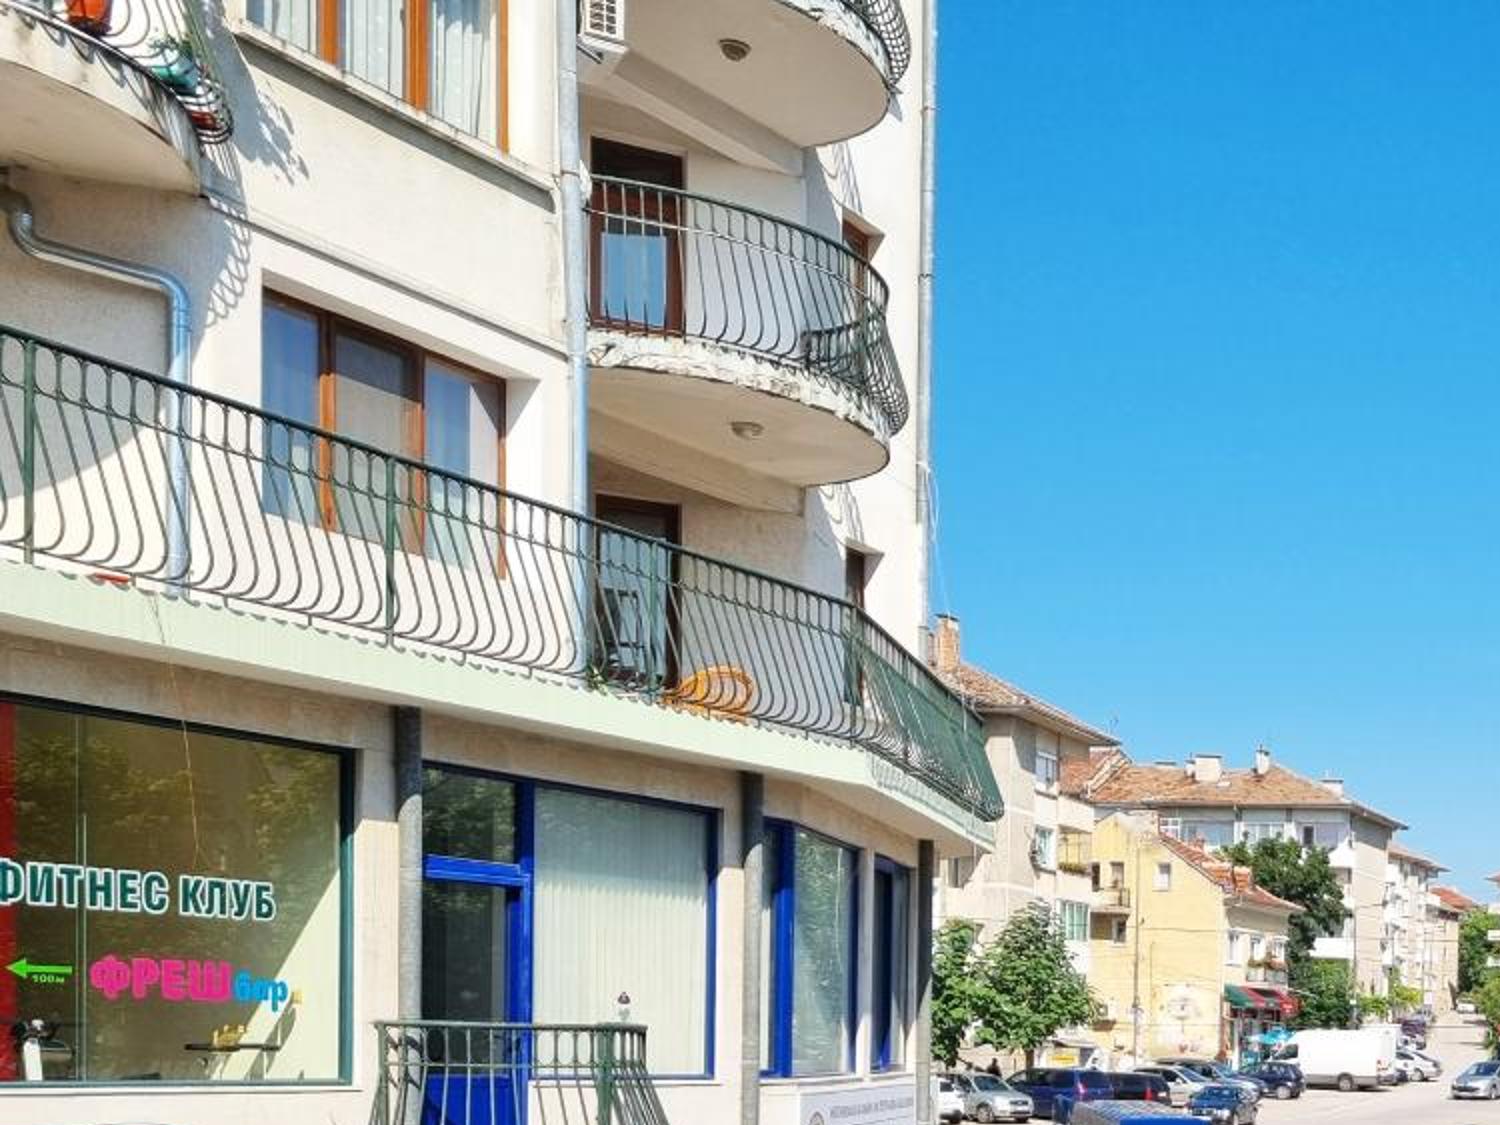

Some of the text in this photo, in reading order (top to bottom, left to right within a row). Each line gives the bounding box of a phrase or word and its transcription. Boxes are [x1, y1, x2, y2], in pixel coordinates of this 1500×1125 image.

[0, 857, 277, 921] ФИТНЕС КЛУБ
[89, 953, 232, 999] ФРЕШ
